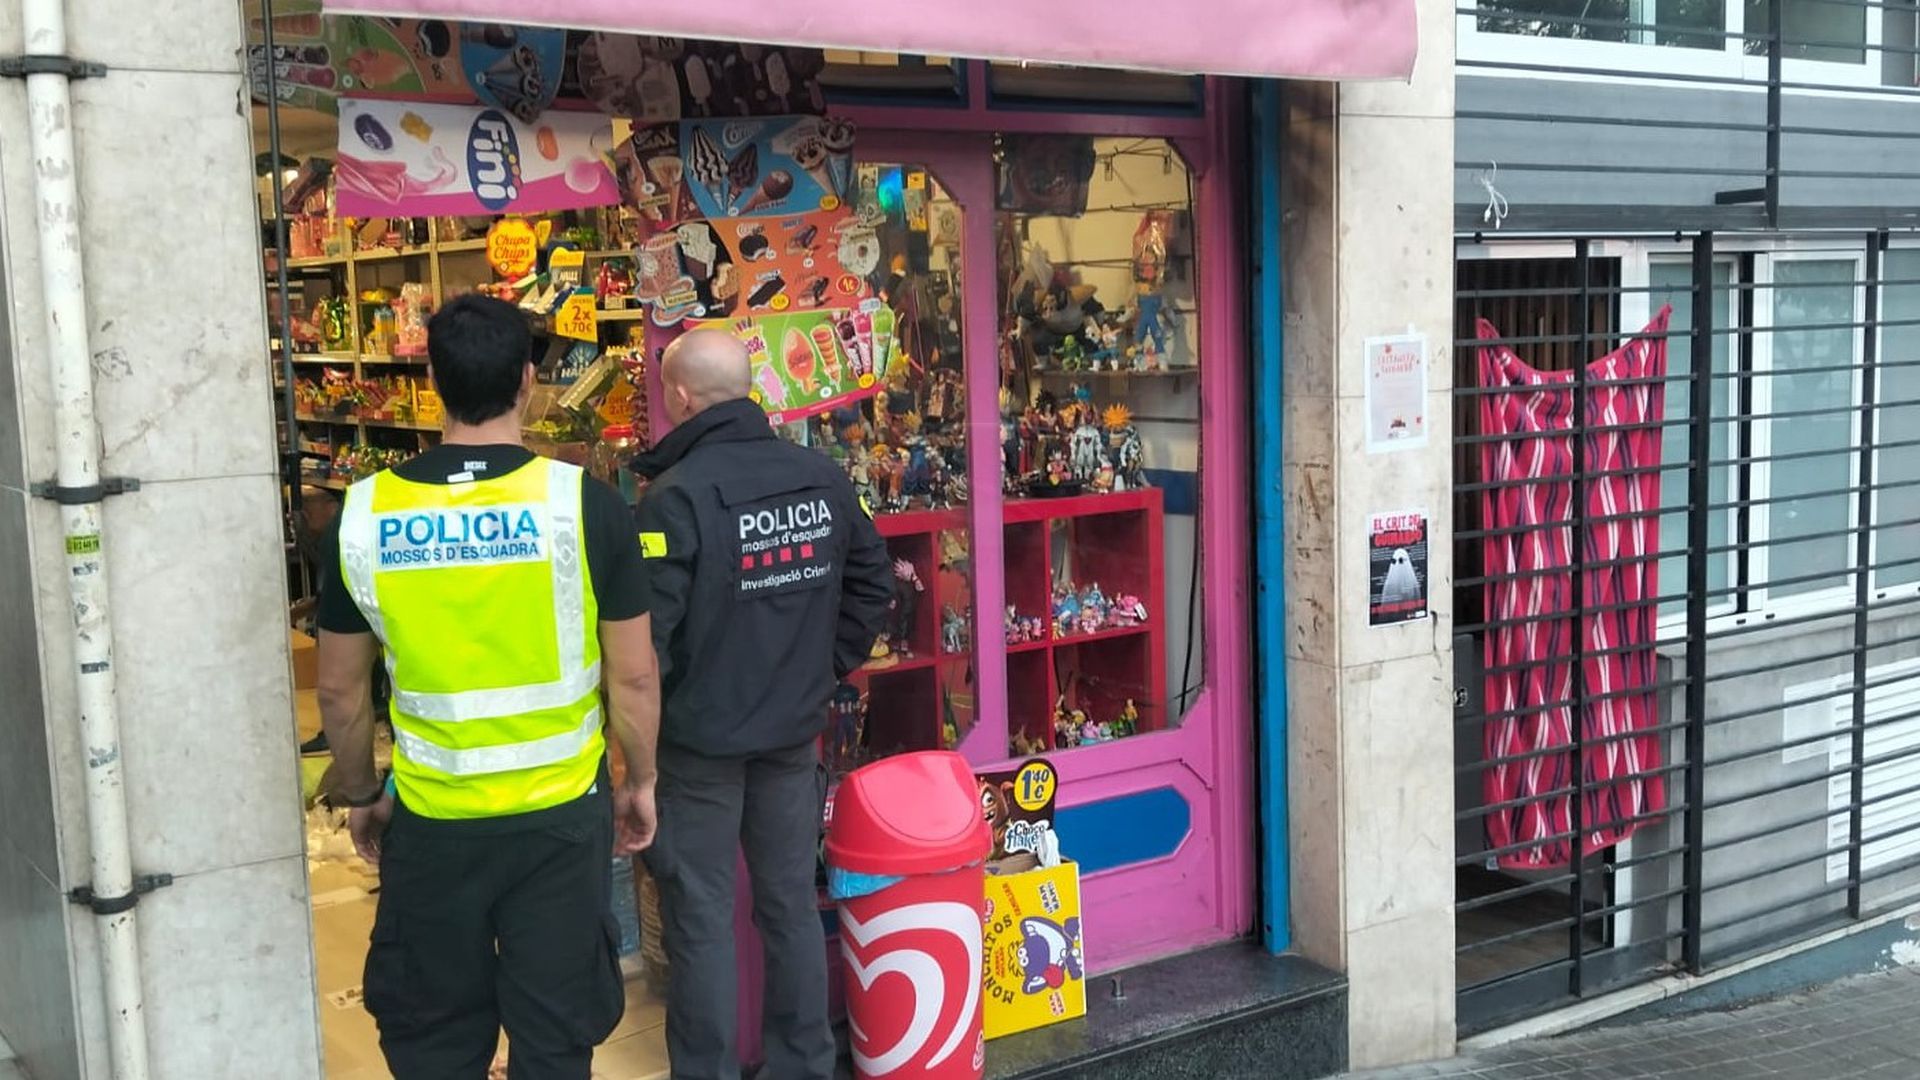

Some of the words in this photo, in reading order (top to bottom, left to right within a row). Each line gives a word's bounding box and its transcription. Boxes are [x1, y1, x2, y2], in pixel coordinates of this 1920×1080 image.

[495, 233, 530, 247] Chupa
[494, 246, 530, 260] Chups
[571, 305, 592, 321] 2x
[379, 509, 539, 548] POLICIA
[739, 500, 832, 539] POLICIA
[381, 548, 442, 565] MOSSOS
[446, 542, 539, 561] D'ESQUADRA
[742, 535, 779, 554] mossos
[741, 569, 801, 591] Investigació
[1007, 829, 1040, 850] flake
[1014, 823, 1045, 836] Choco
[983, 913, 1015, 1004] MONCHITOS
